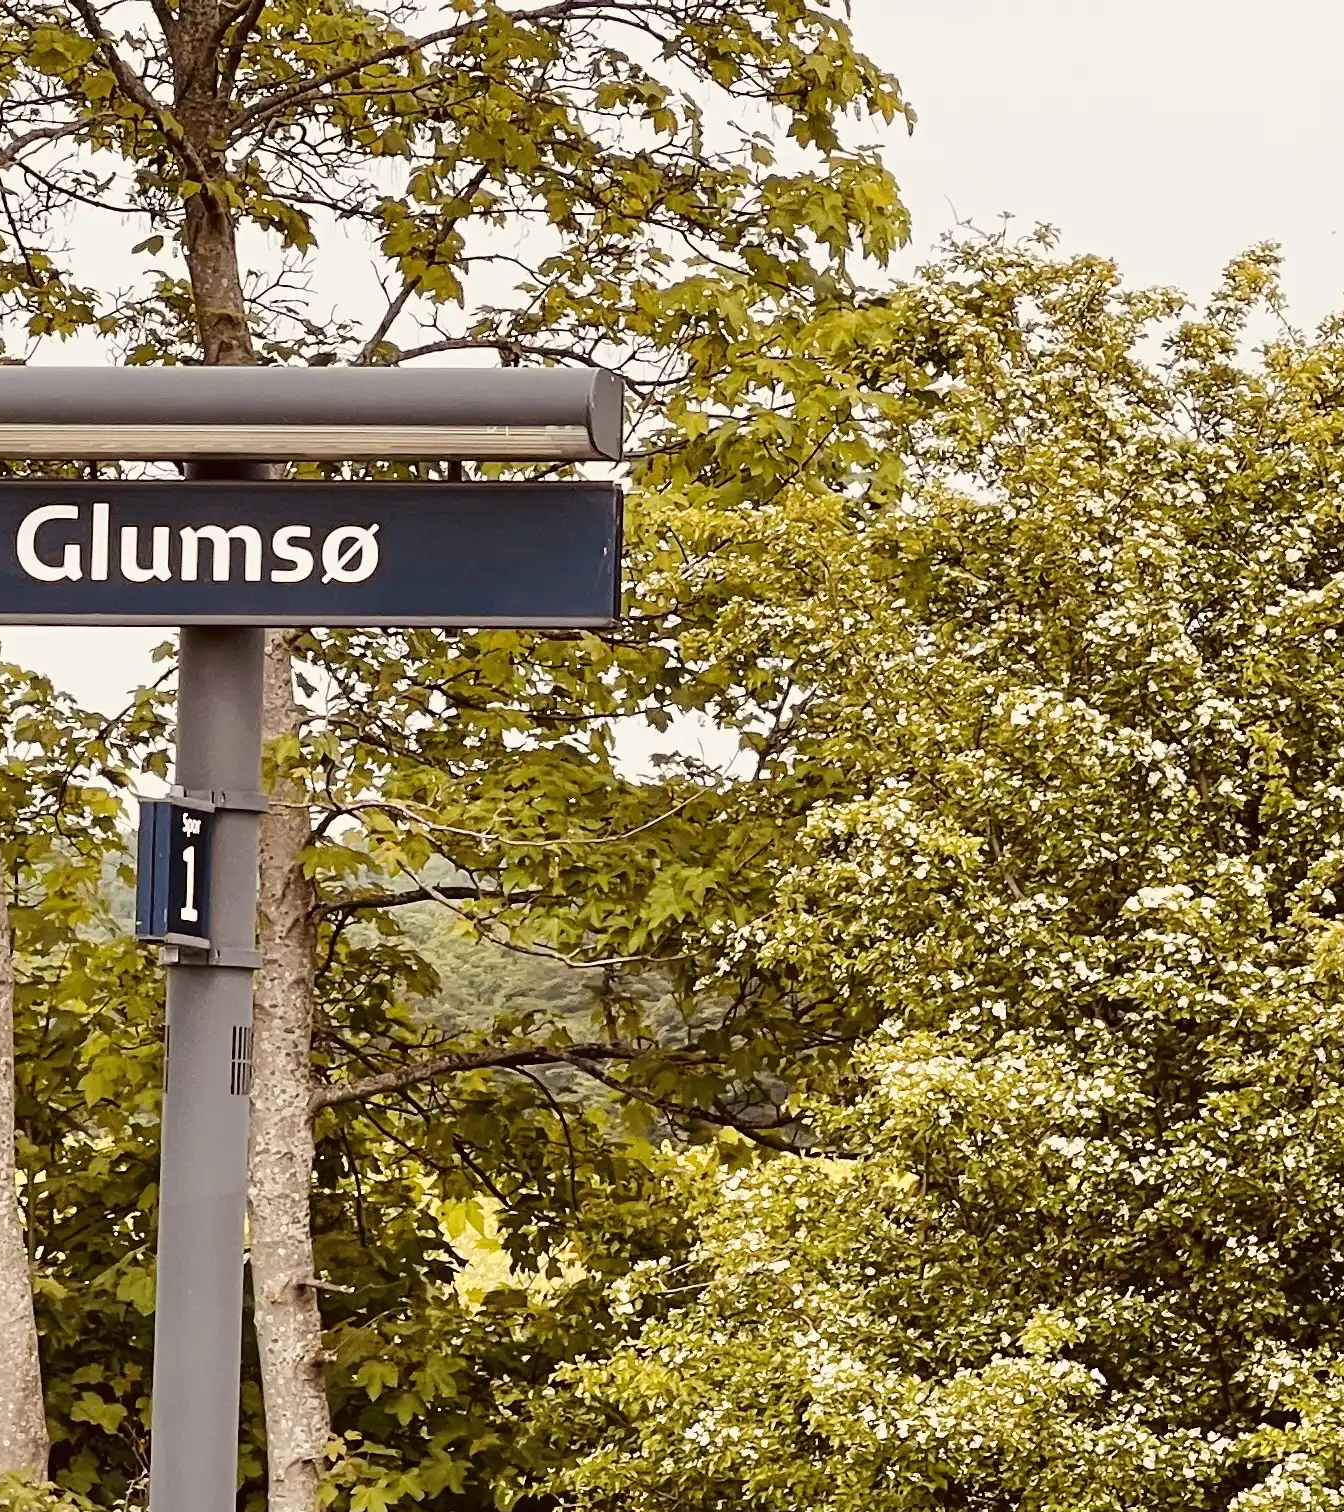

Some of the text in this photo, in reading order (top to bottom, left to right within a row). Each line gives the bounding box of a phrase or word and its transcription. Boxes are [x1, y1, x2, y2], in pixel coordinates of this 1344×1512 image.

[15, 502, 380, 584] Glumsø
[182, 812, 202, 838] Spor
[180, 845, 199, 923] 1
